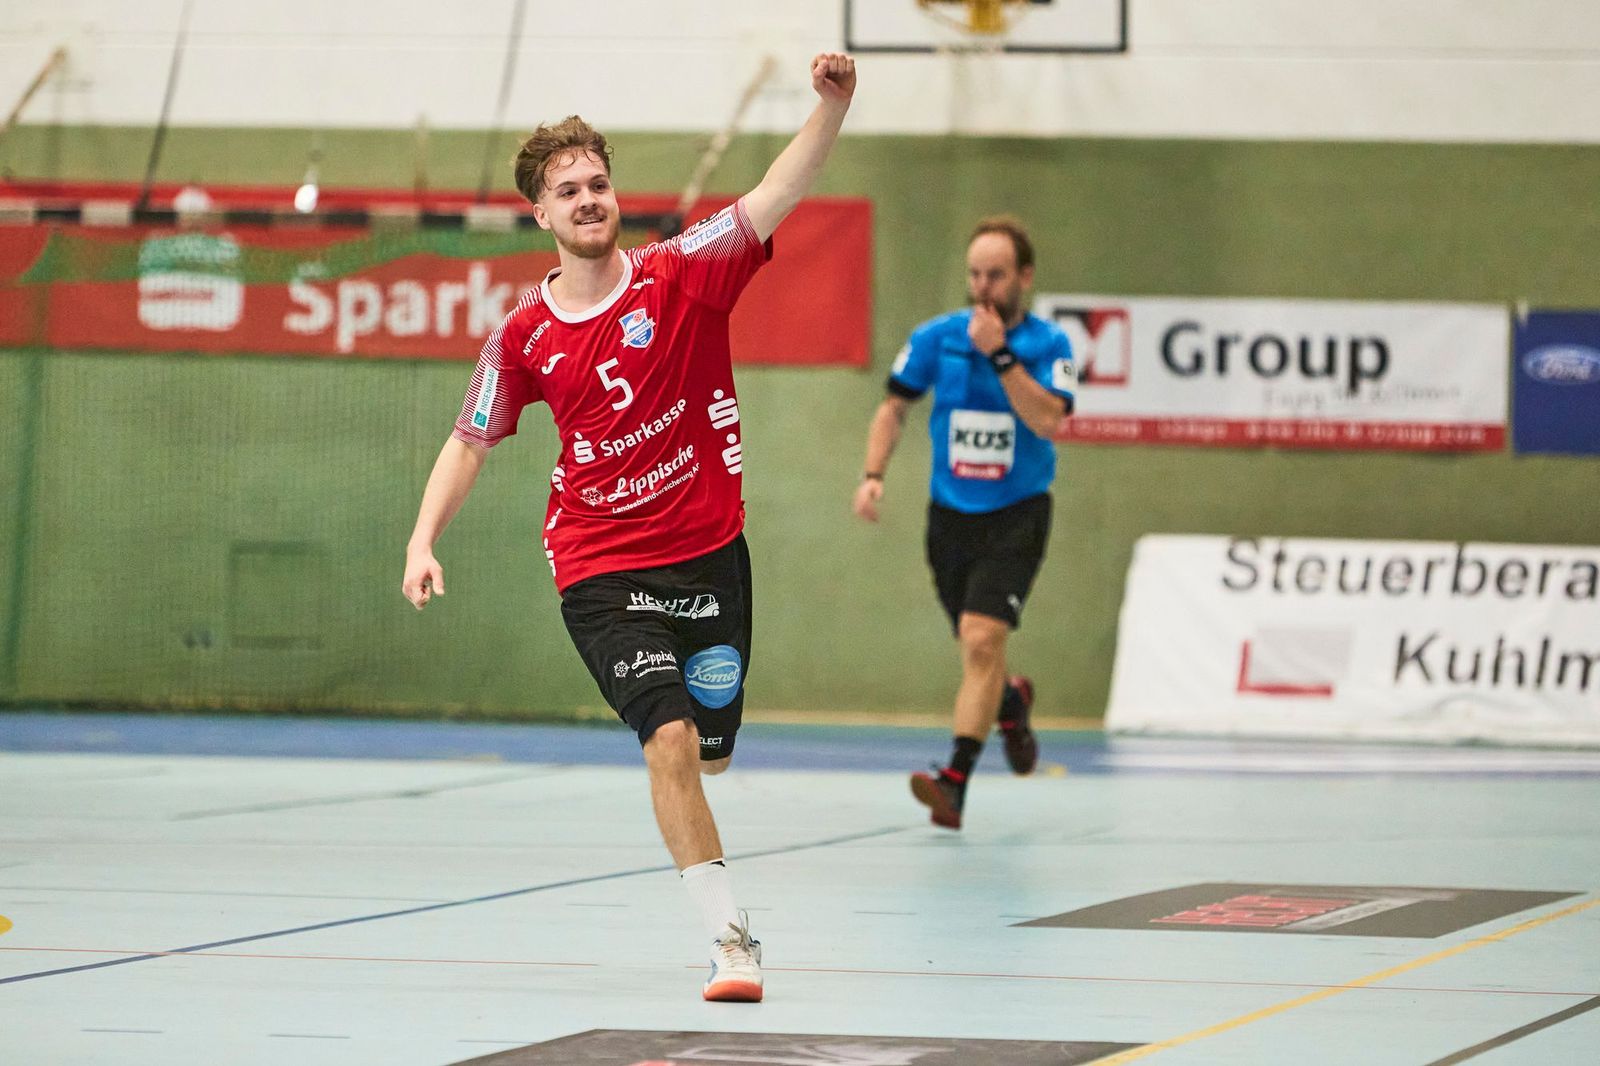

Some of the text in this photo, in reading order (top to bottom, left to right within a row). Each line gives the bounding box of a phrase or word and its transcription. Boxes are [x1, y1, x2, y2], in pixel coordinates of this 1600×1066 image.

[284, 263, 532, 353] Spark
[596, 357, 634, 411] 5
[1159, 319, 1391, 394] Group
[480, 369, 495, 411] INGENHAAG
[600, 399, 687, 456] Sparkasse
[607, 444, 694, 502] Lippische
[1222, 537, 1600, 599] Steuerbera
[631, 651, 677, 670] Lippisch
[699, 736, 723, 745] ELECT
